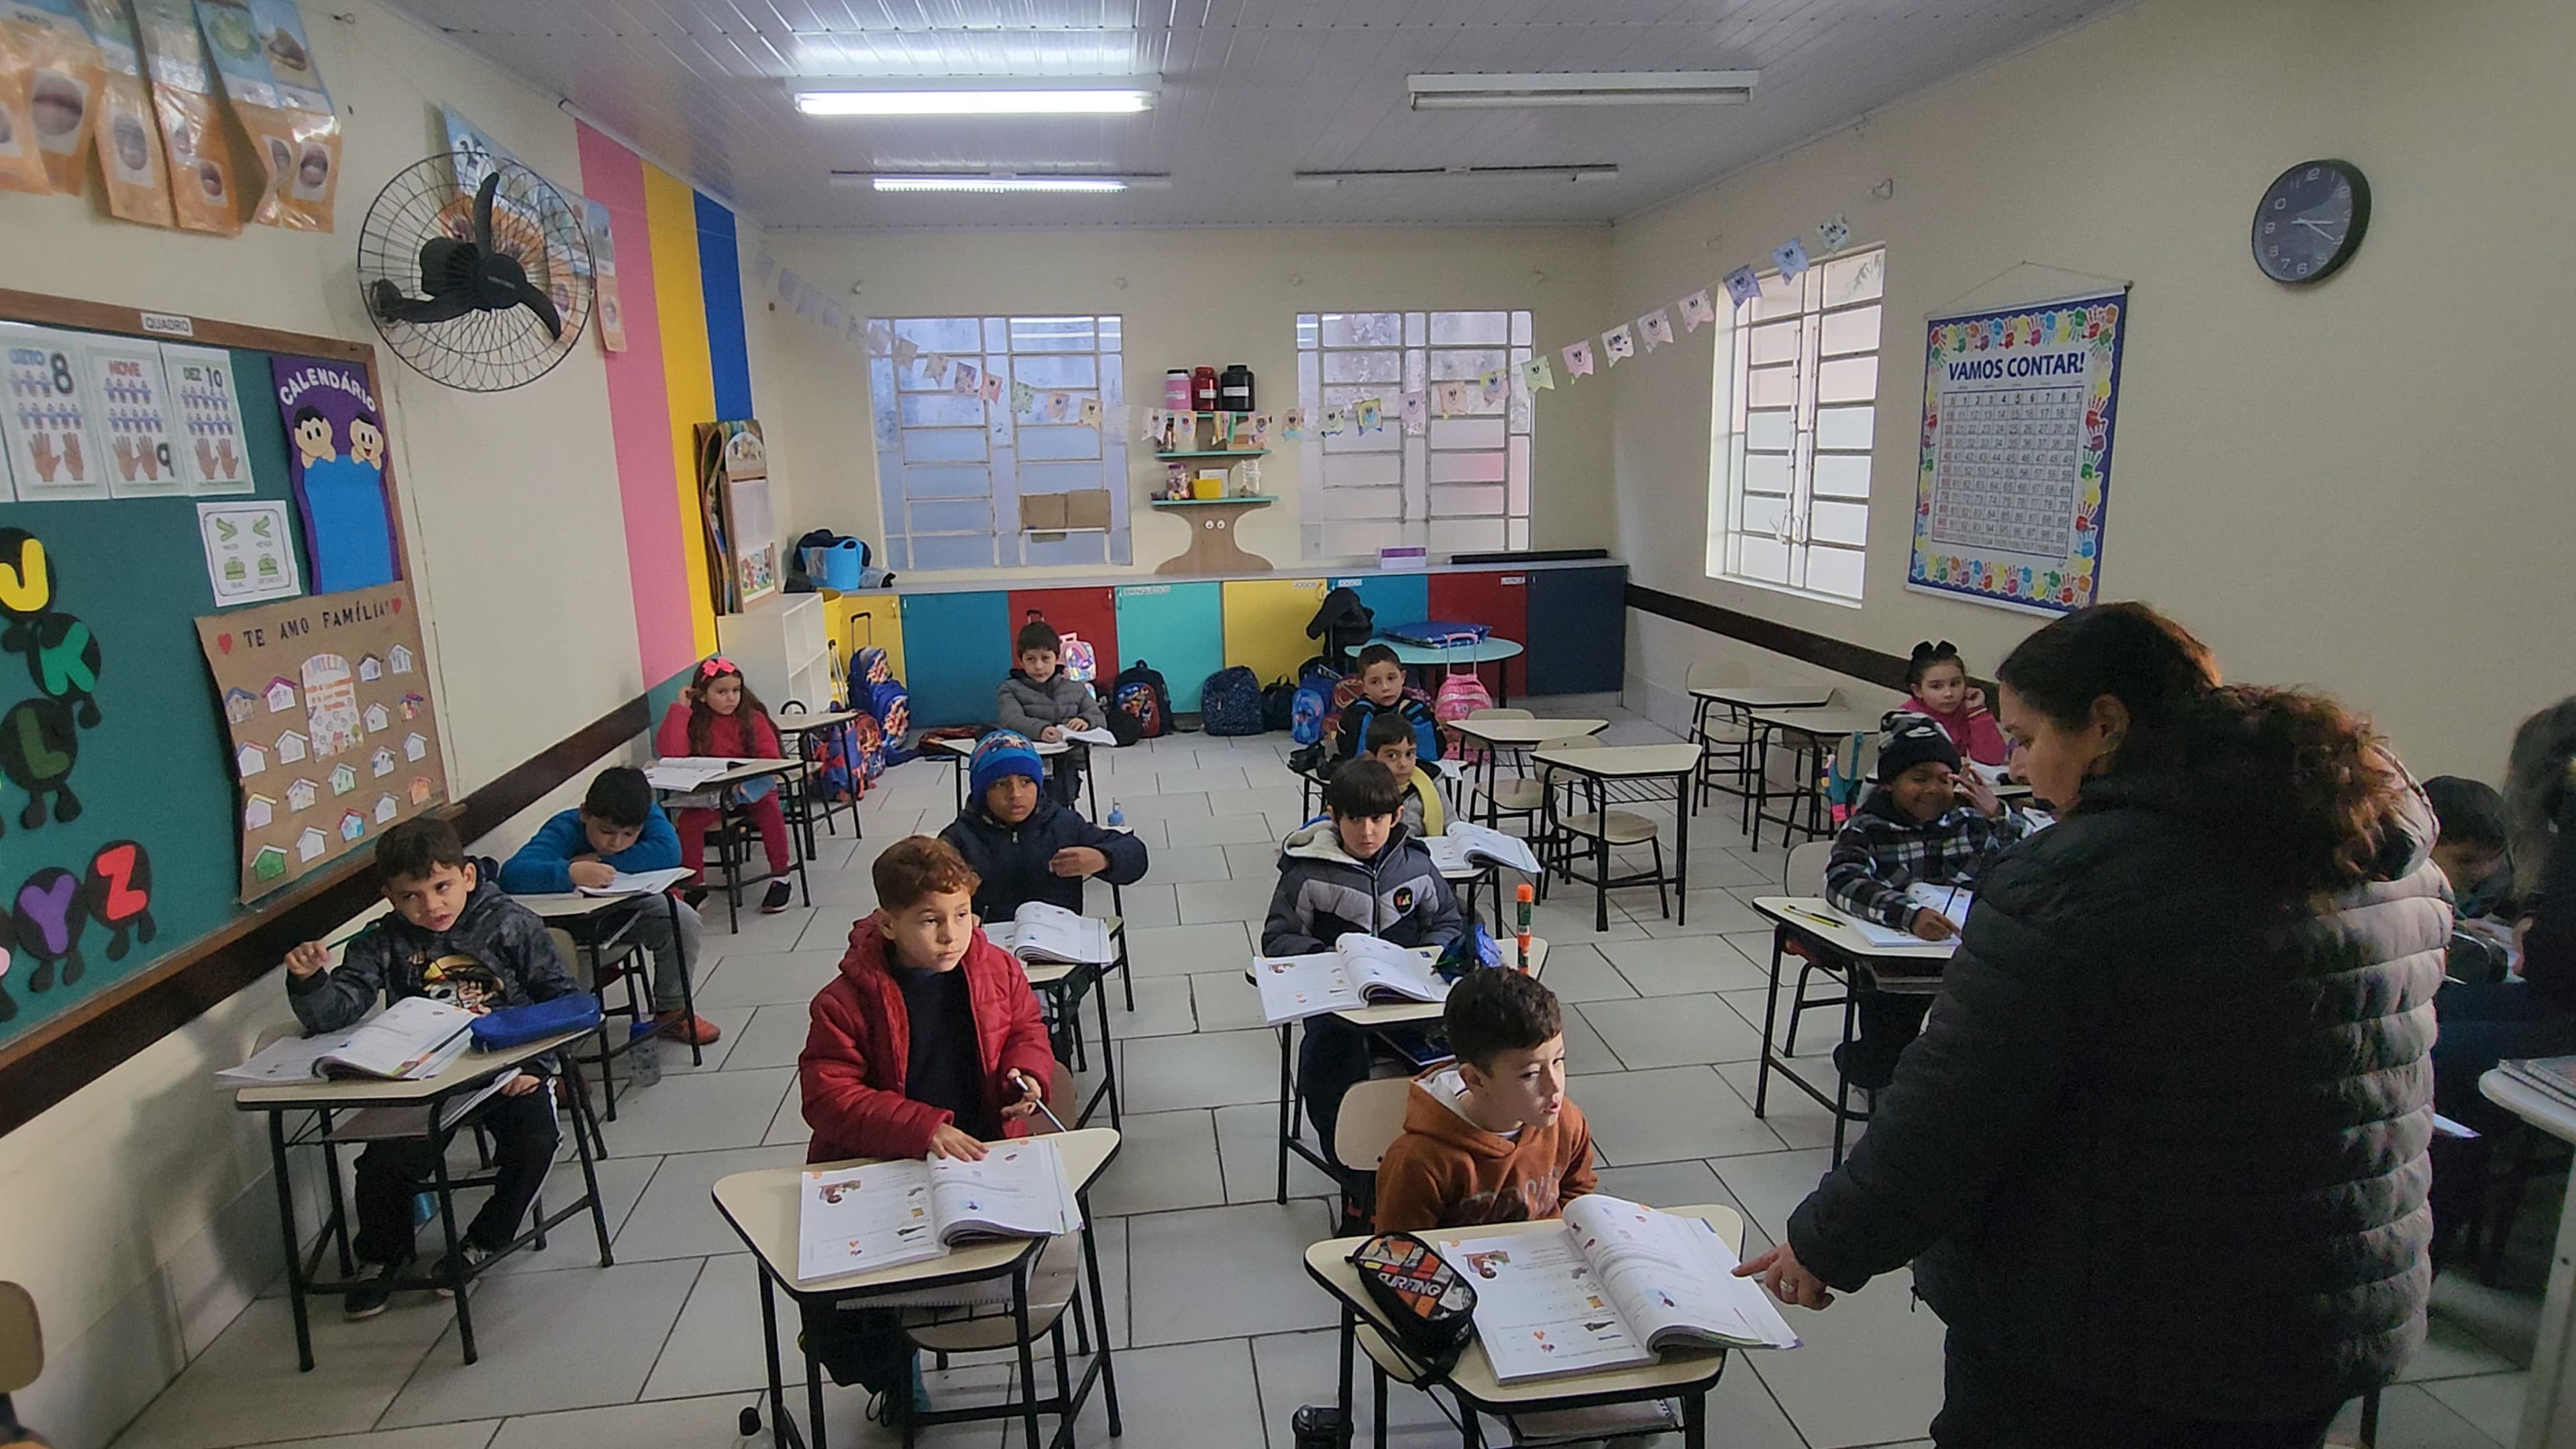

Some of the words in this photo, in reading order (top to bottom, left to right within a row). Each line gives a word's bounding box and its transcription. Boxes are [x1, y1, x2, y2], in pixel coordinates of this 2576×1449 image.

[2265, 222, 2275, 234] 9
[2269, 246, 2279, 256] 8
[2281, 258, 2291, 268] 7
[2297, 263, 2308, 274] 6
[146, 317, 190, 331] QUADRO
[50, 352, 74, 394] 8
[108, 360, 142, 377] NOVE
[182, 366, 203, 381] DEZ
[205, 366, 223, 388] 10
[1949, 359, 2003, 381] VAMOS
[2007, 352, 2085, 377] CONTAR!
[280, 368, 376, 412] CALENDÁRIO
[1976, 396, 1980, 404] 2
[1989, 395, 1993, 403] 3
[2015, 394, 2021, 403] 5
[2030, 394, 2035, 402] 6
[2045, 393, 2052, 402] 7
[2061, 392, 2066, 402] 8
[2076, 392, 2081, 401] 9
[156, 442, 175, 478] 9
[0, 539, 49, 612] J
[243, 628, 266, 648] TE
[280, 617, 309, 639] AMO
[40, 621, 95, 695] K
[16, 709, 68, 778] L
[97, 844, 148, 920] Z
[19, 873, 76, 953] Y
